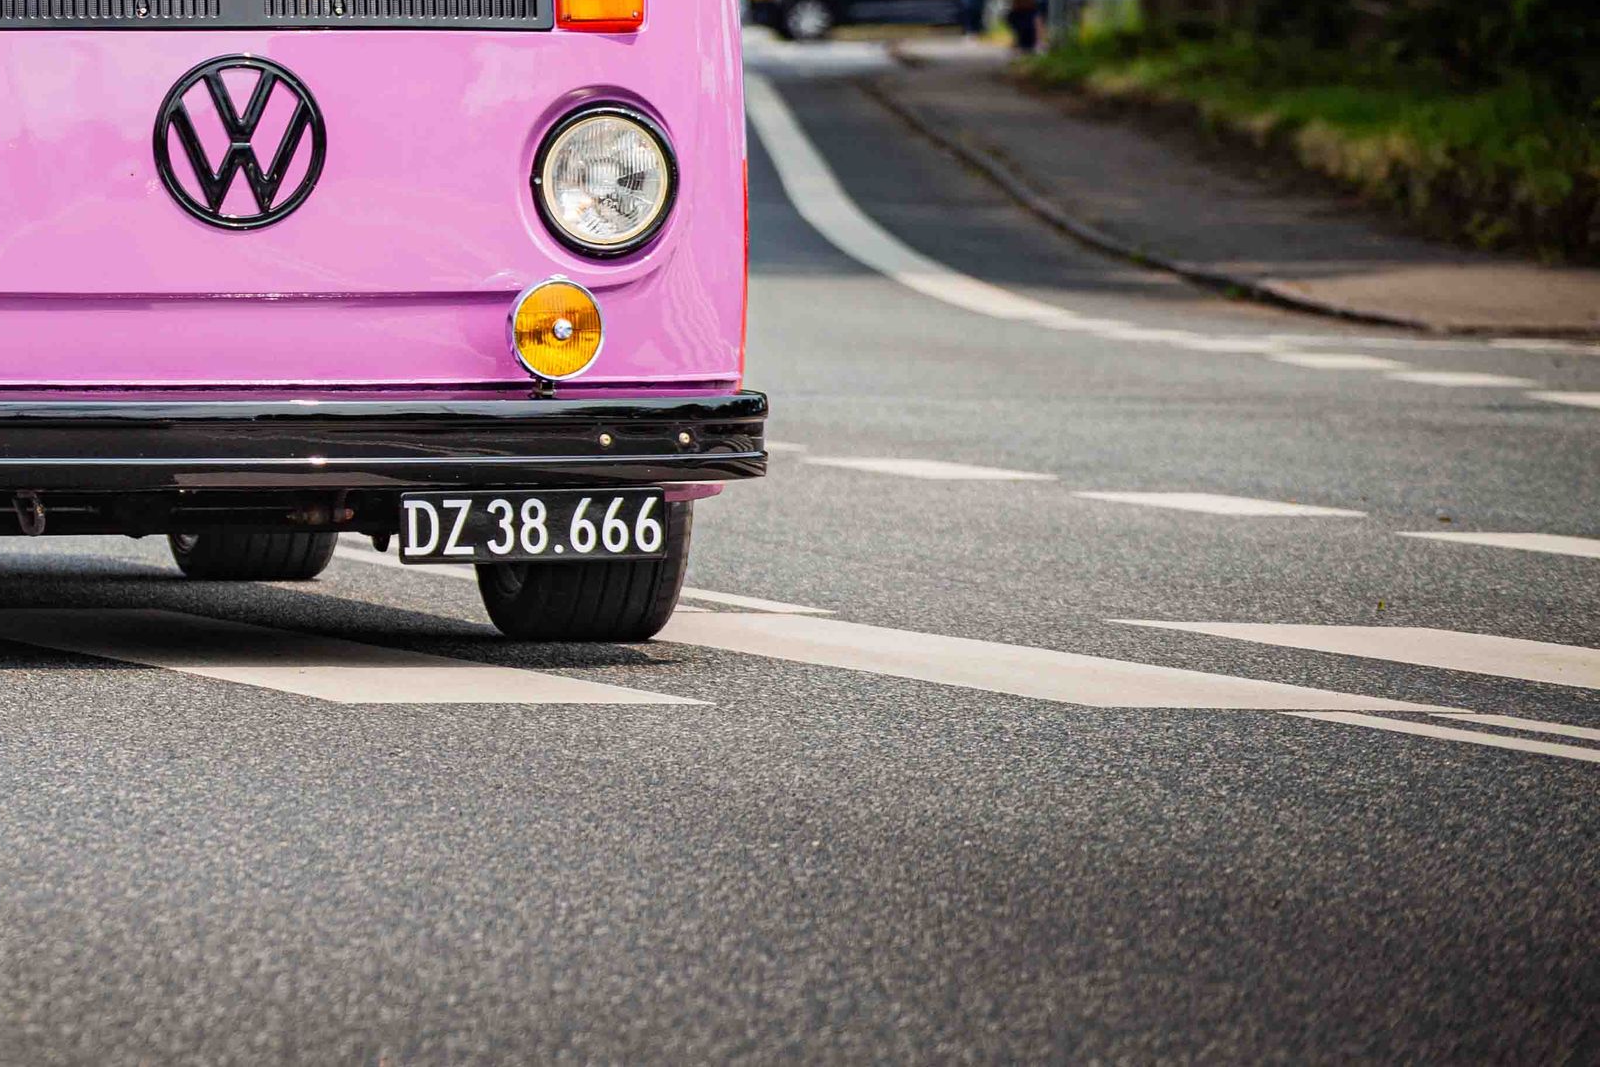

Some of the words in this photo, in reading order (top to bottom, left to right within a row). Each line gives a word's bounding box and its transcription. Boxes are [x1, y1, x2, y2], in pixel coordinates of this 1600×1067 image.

[162, 62, 318, 222] VW
[403, 498, 475, 556] DZ
[486, 497, 663, 555] 38.666
